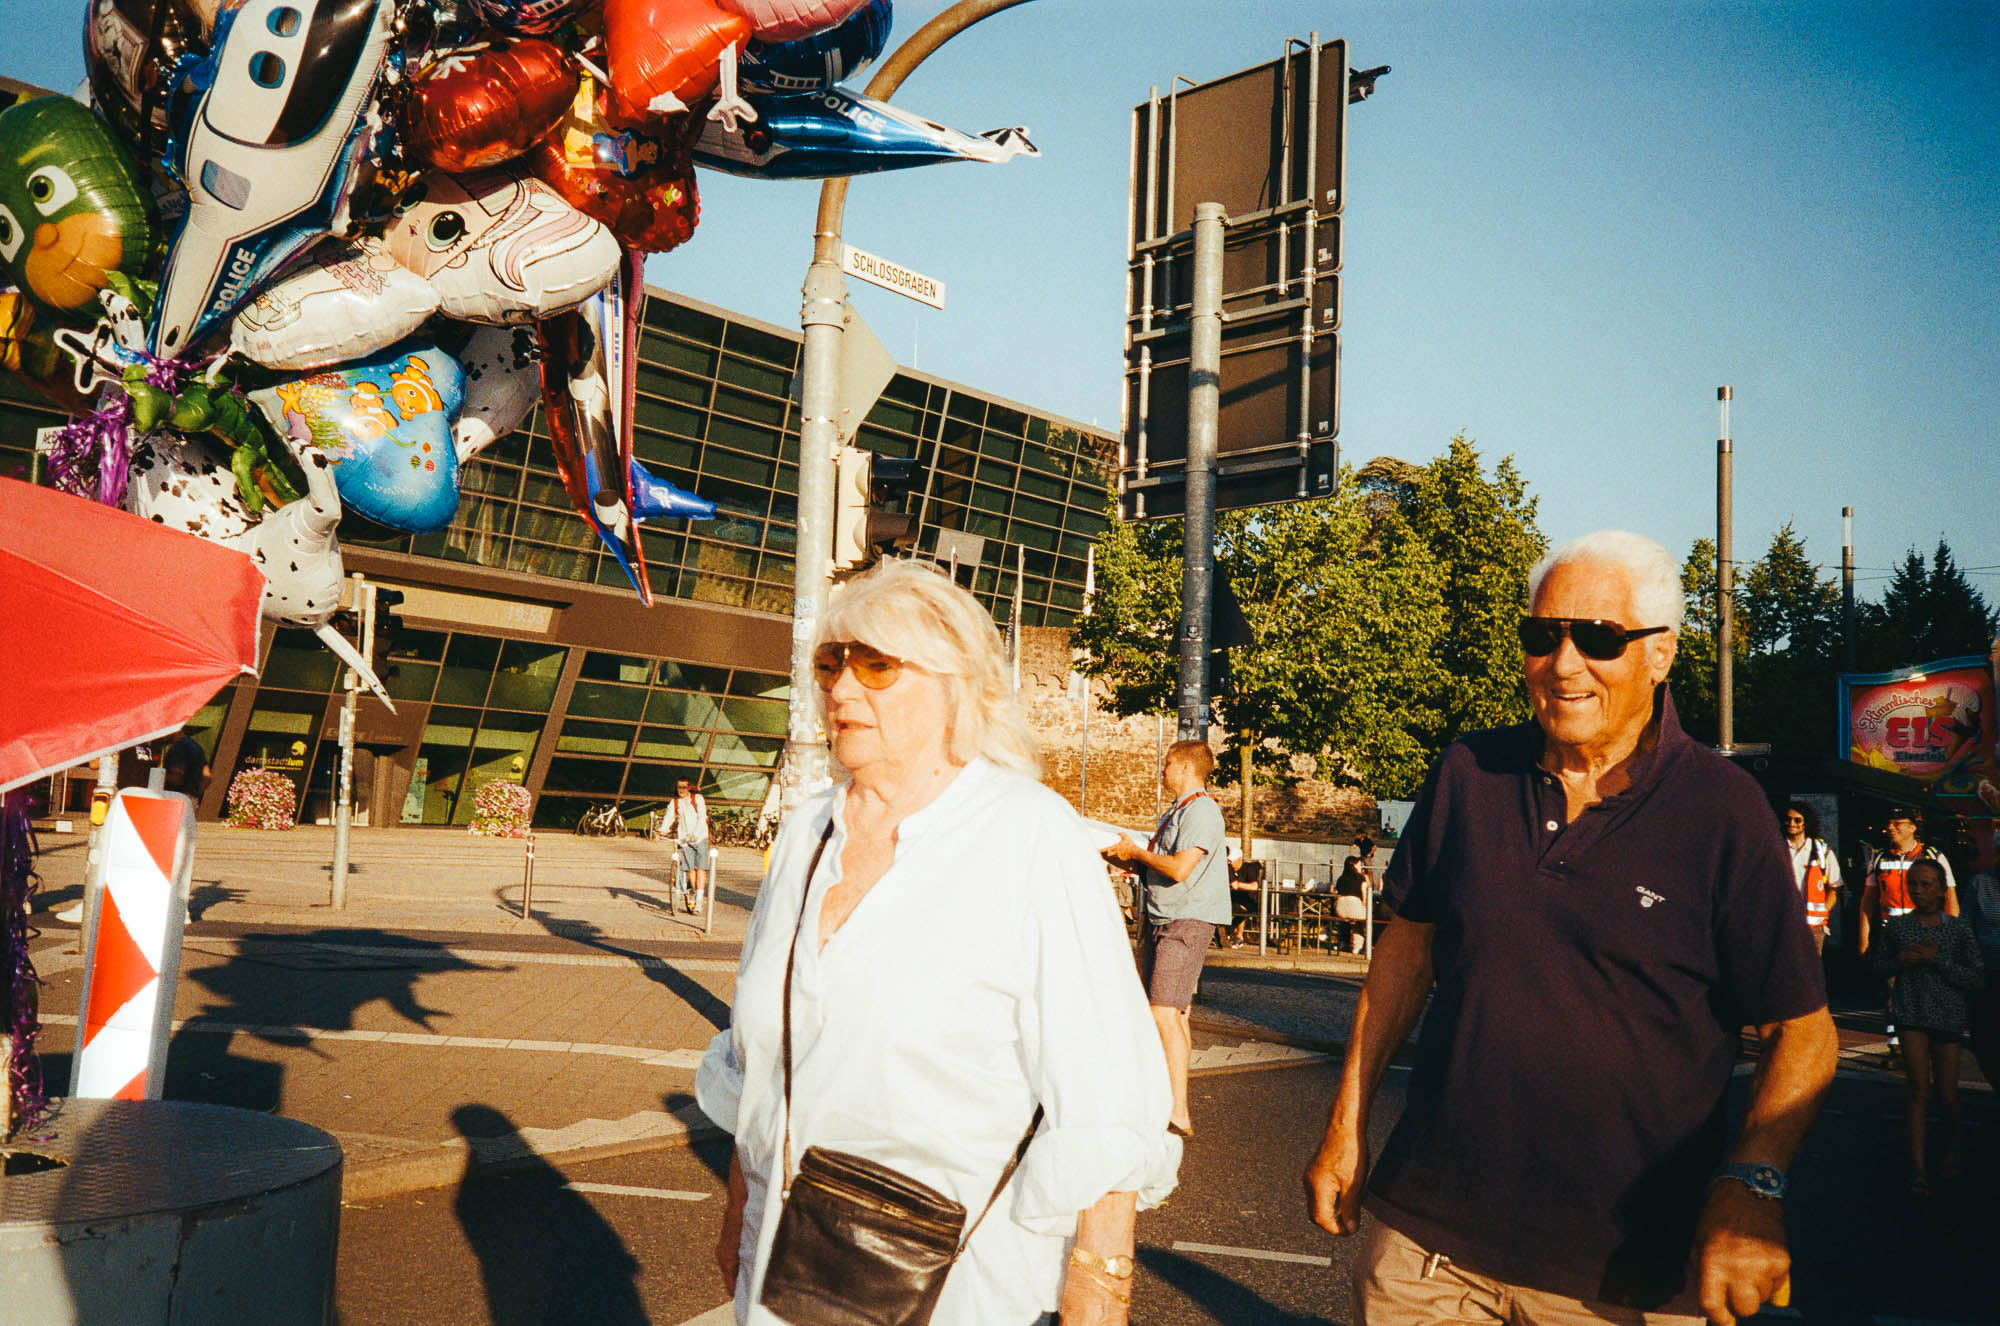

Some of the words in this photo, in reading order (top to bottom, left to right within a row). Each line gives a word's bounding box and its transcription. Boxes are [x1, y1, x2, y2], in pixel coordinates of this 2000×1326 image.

[213, 247, 257, 312] POLICE
[852, 251, 937, 299] SCHLOSSGRABEN
[1886, 716, 1955, 748] EIS
[1635, 885, 1666, 903] GANT
